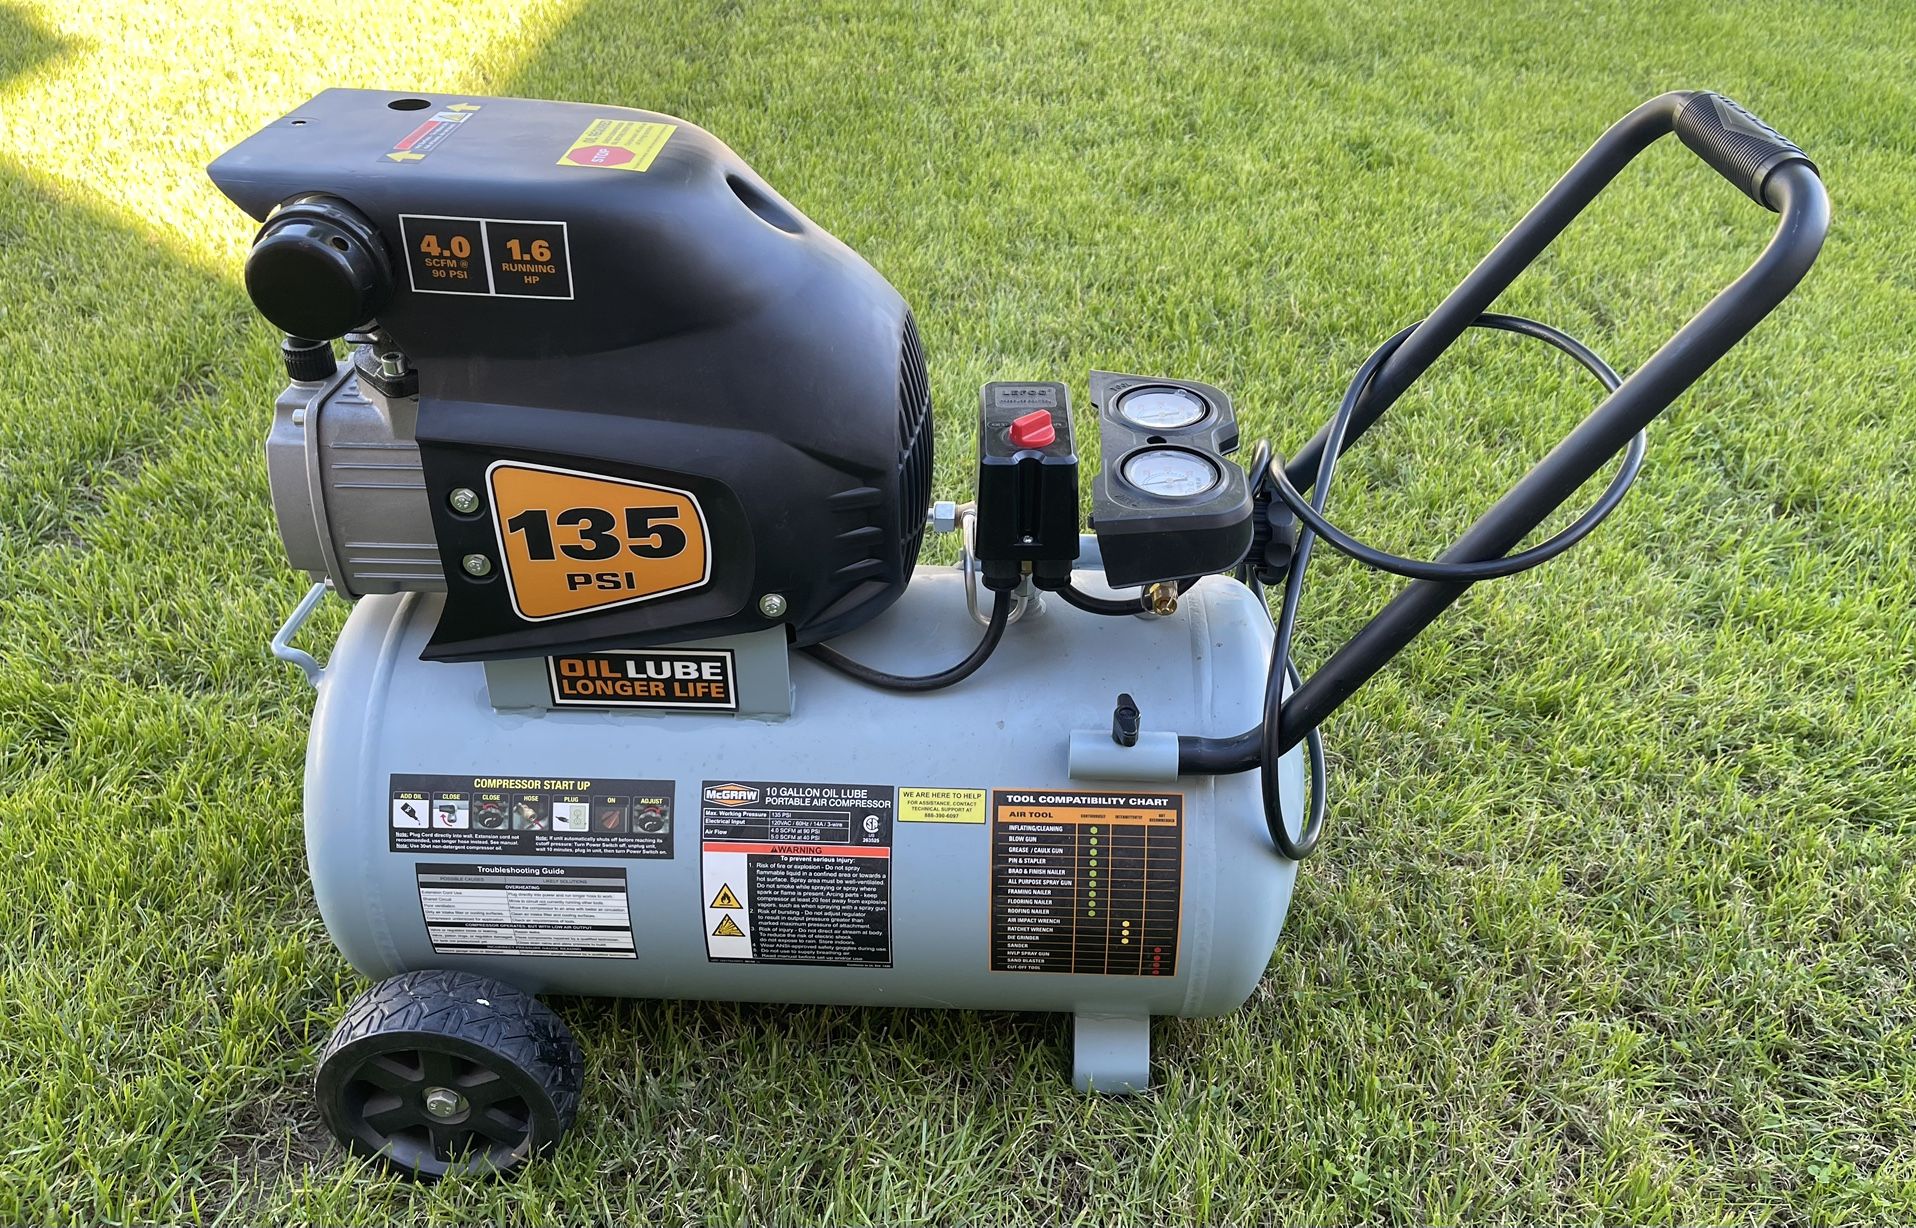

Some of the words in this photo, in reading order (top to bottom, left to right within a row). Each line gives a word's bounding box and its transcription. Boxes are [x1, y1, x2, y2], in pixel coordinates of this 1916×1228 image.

[591, 148, 610, 163] STOP
[420, 235, 470, 258] 4.0
[506, 239, 551, 262] 1.6
[425, 258, 457, 268] SCFM
[460, 260, 468, 268] @
[502, 263, 555, 273] RUNNING
[432, 270, 446, 278] 90
[450, 270, 468, 279] PSI
[524, 276, 540, 284] HP
[507, 504, 688, 561] 135
[566, 571, 636, 591] PSI
[559, 659, 622, 678] OIL
[625, 660, 723, 680] LUBE
[562, 679, 666, 697] LONGER
[673, 682, 725, 698] LIFE
[474, 779, 541, 789] COMPRESSOR
[543, 781, 574, 790] START
[577, 781, 591, 790] UP
[706, 790, 757, 800] McGRAW
[766, 787, 777, 796] 10
[780, 787, 820, 797] GALLON
[822, 789, 839, 798] OIL
[841, 789, 867, 798] LUBE
[765, 797, 810, 806] PORTABLE
[812, 798, 827, 807] AIR
[829, 799, 891, 809] COMPRESSOR
[1006, 795, 1036, 803] TOOL
[1039, 796, 1126, 805] COMPATIBILITY
[1129, 798, 1169, 806] CHART
[778, 846, 822, 854] WARNING
[477, 866, 540, 875] Troubleshooting
[542, 867, 564, 875] Guide
